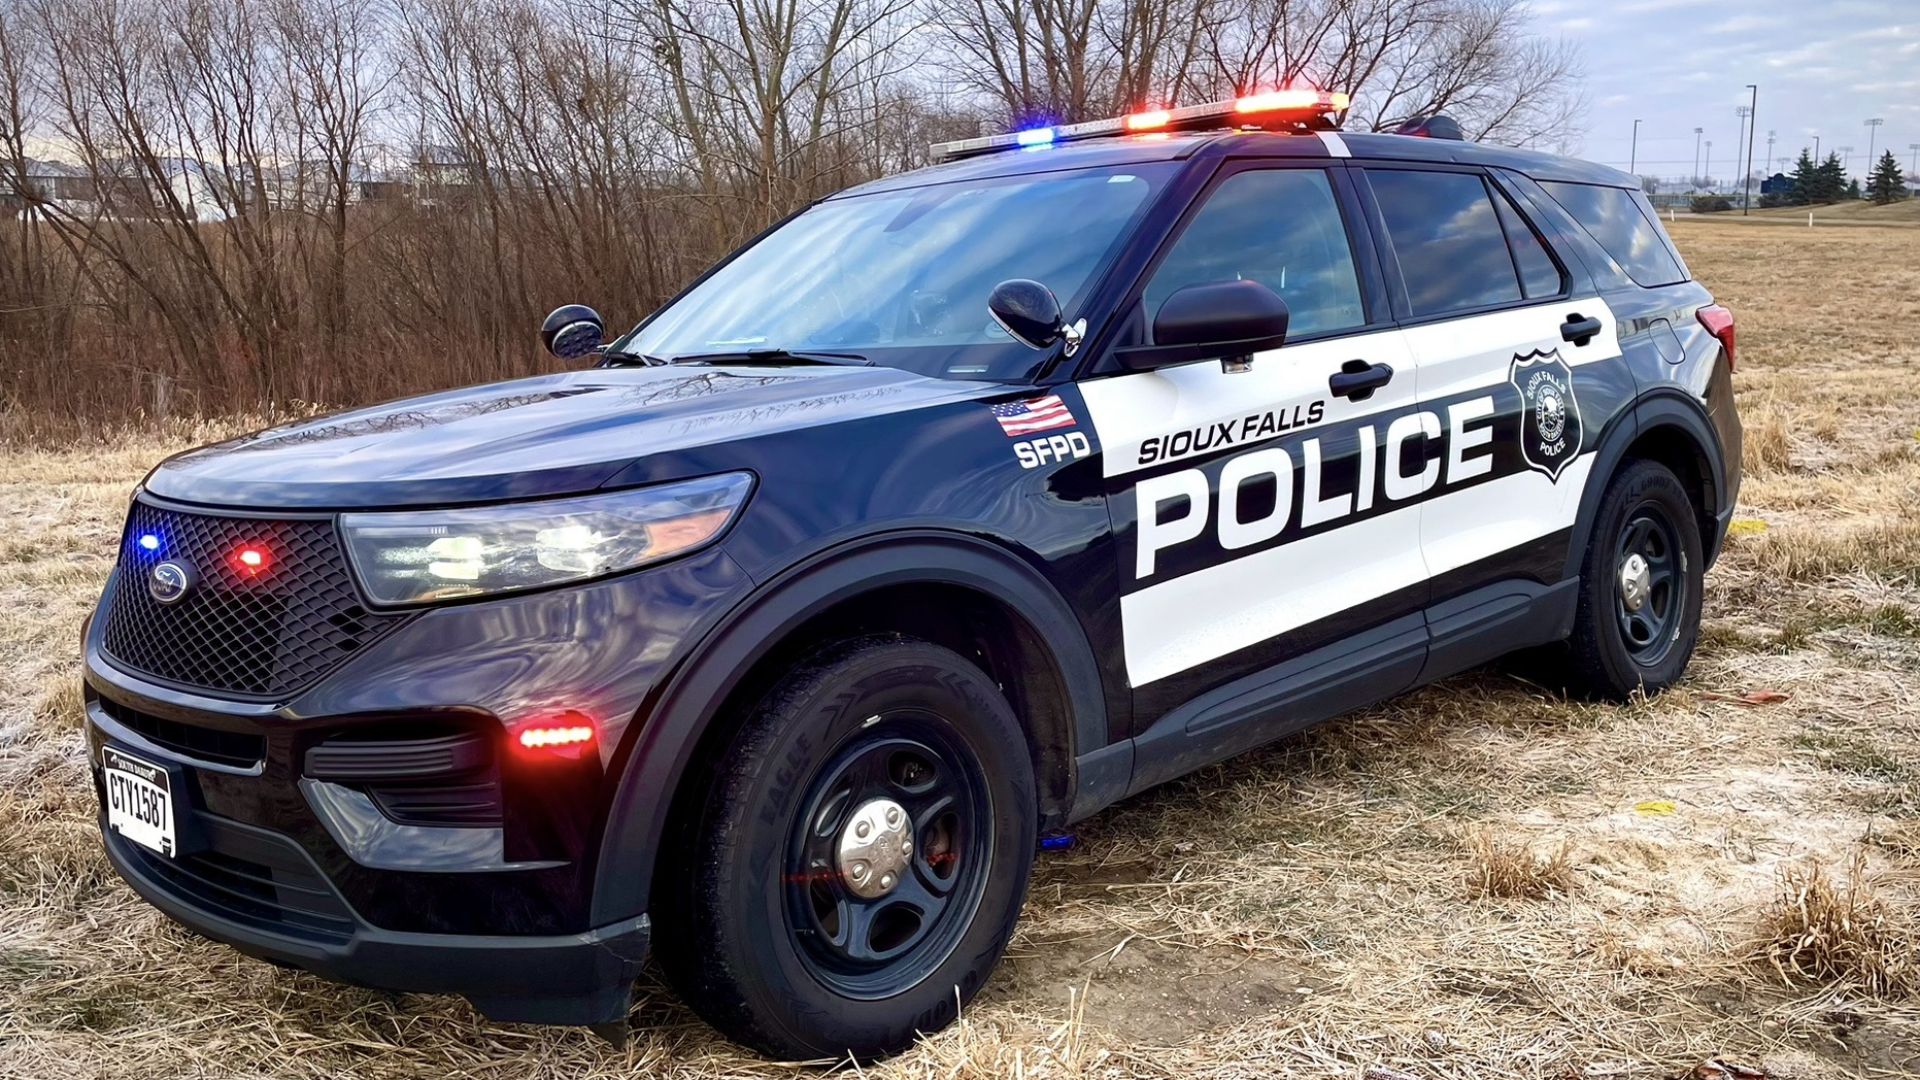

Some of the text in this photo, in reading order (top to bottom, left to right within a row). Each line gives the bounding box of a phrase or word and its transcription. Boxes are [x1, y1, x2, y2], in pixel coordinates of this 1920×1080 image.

[1526, 370, 1567, 400] SIOUX FALLS
[1014, 431, 1091, 470] SFPD
[1138, 400, 1325, 465] SIOUX FALLS
[1539, 437, 1567, 457] POLICE
[1135, 396, 1496, 580] POLICE
[109, 772, 167, 832] CTY1587
